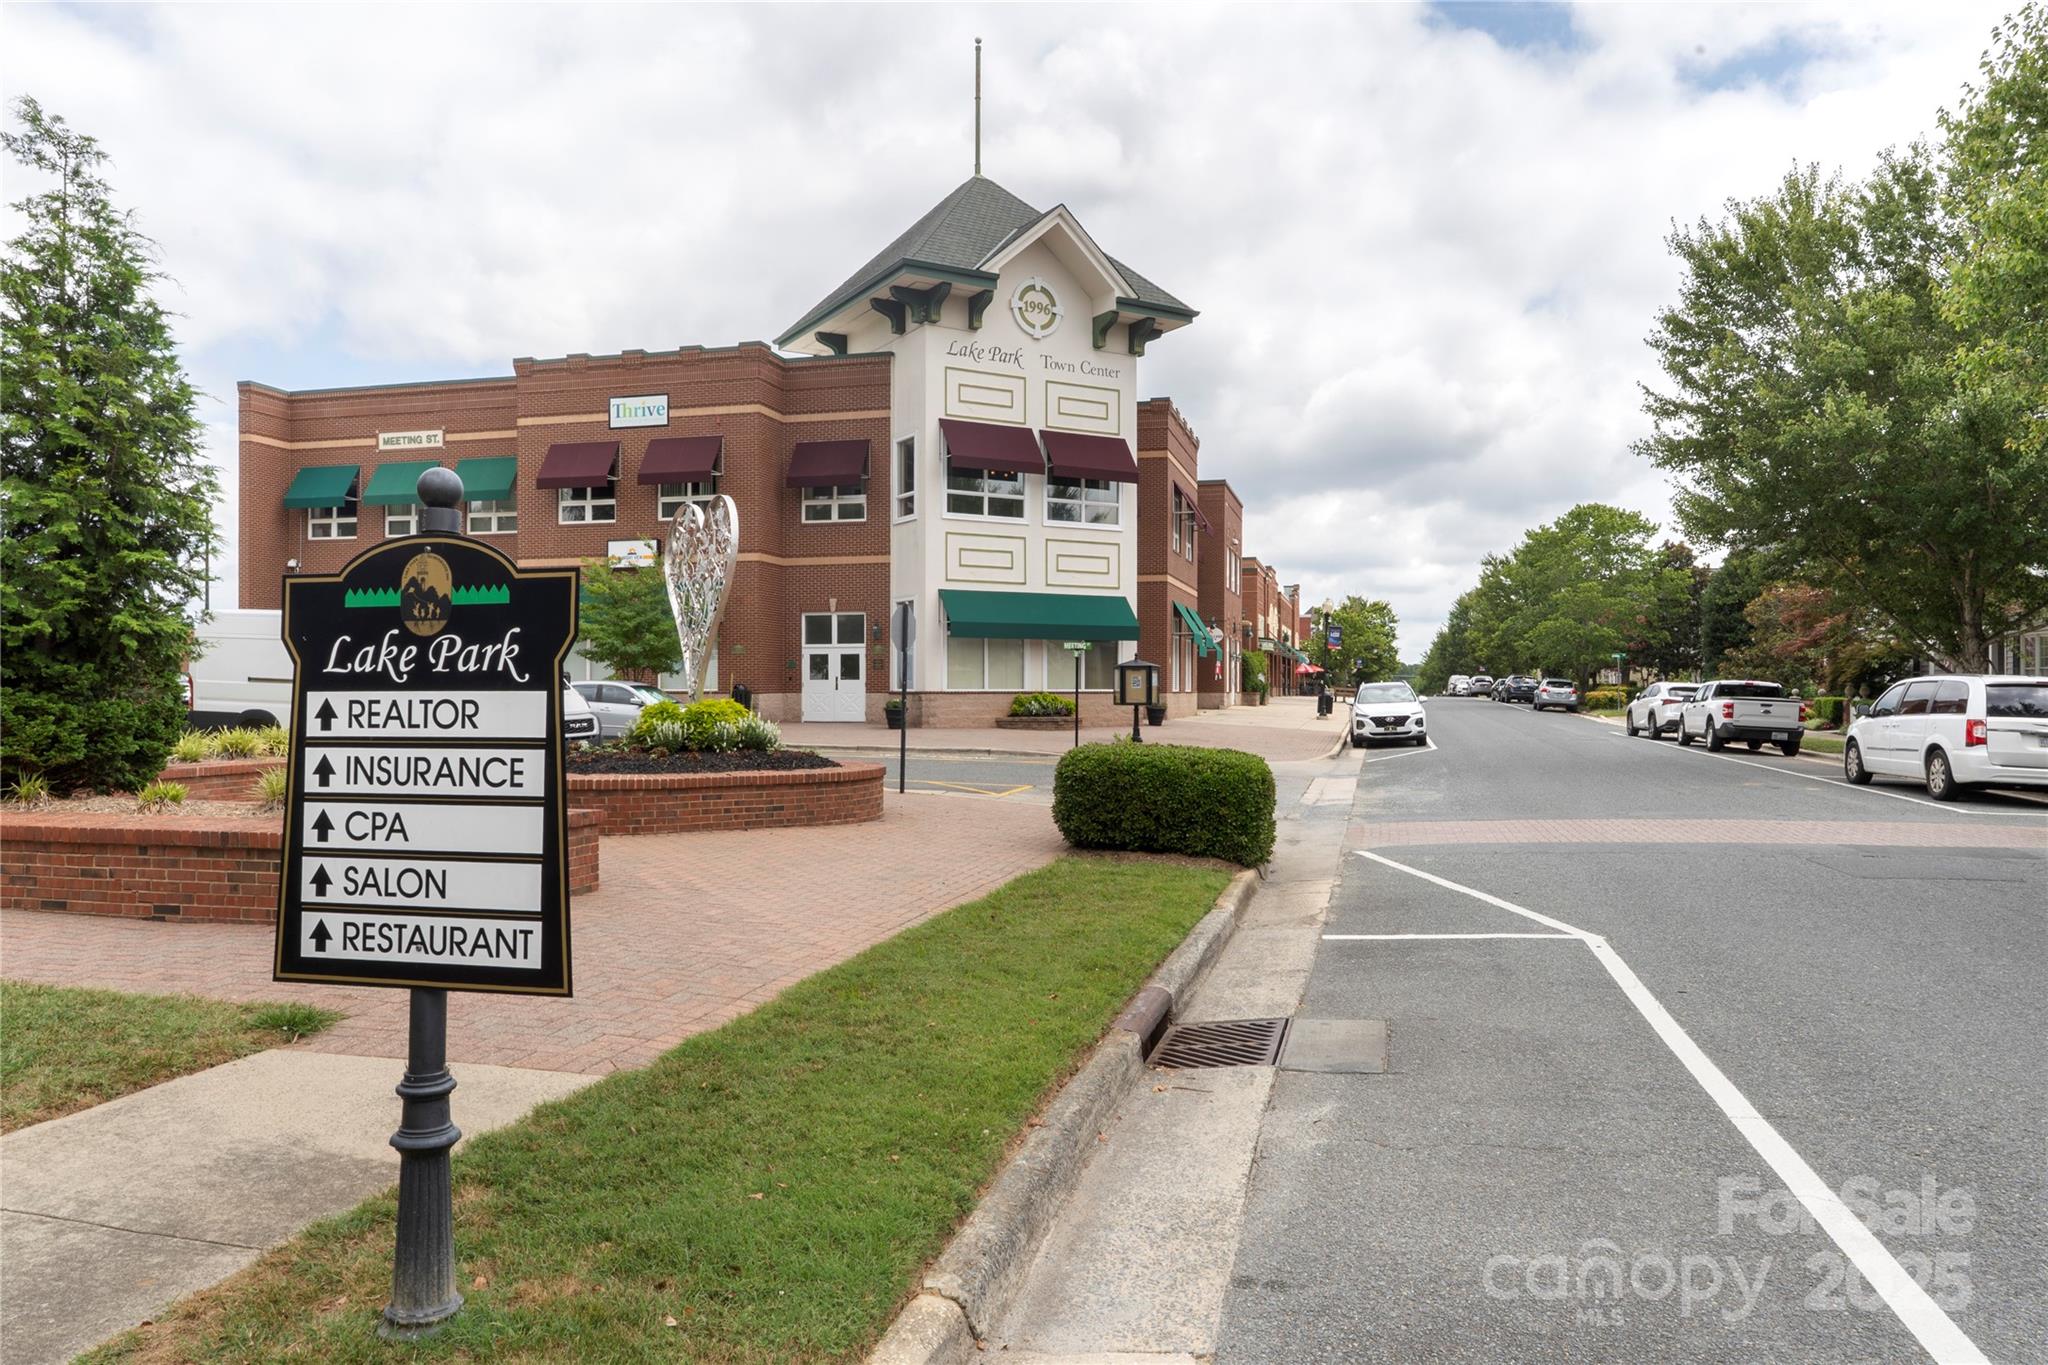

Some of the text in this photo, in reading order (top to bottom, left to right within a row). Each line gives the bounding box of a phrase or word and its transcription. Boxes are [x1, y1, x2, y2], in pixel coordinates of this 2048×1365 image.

[1023, 300, 1052, 316] 1996
[947, 341, 1121, 379] Lake Park Town Center
[612, 400, 666, 419] Thrive
[382, 433, 441, 447] MEETING ST.
[322, 627, 530, 683] Lake Park
[347, 698, 480, 730] REALTOR
[345, 755, 525, 788] INSURANCE
[344, 810, 409, 843] CPA
[343, 866, 448, 899] SALON
[342, 922, 534, 960] RESTAURANT
